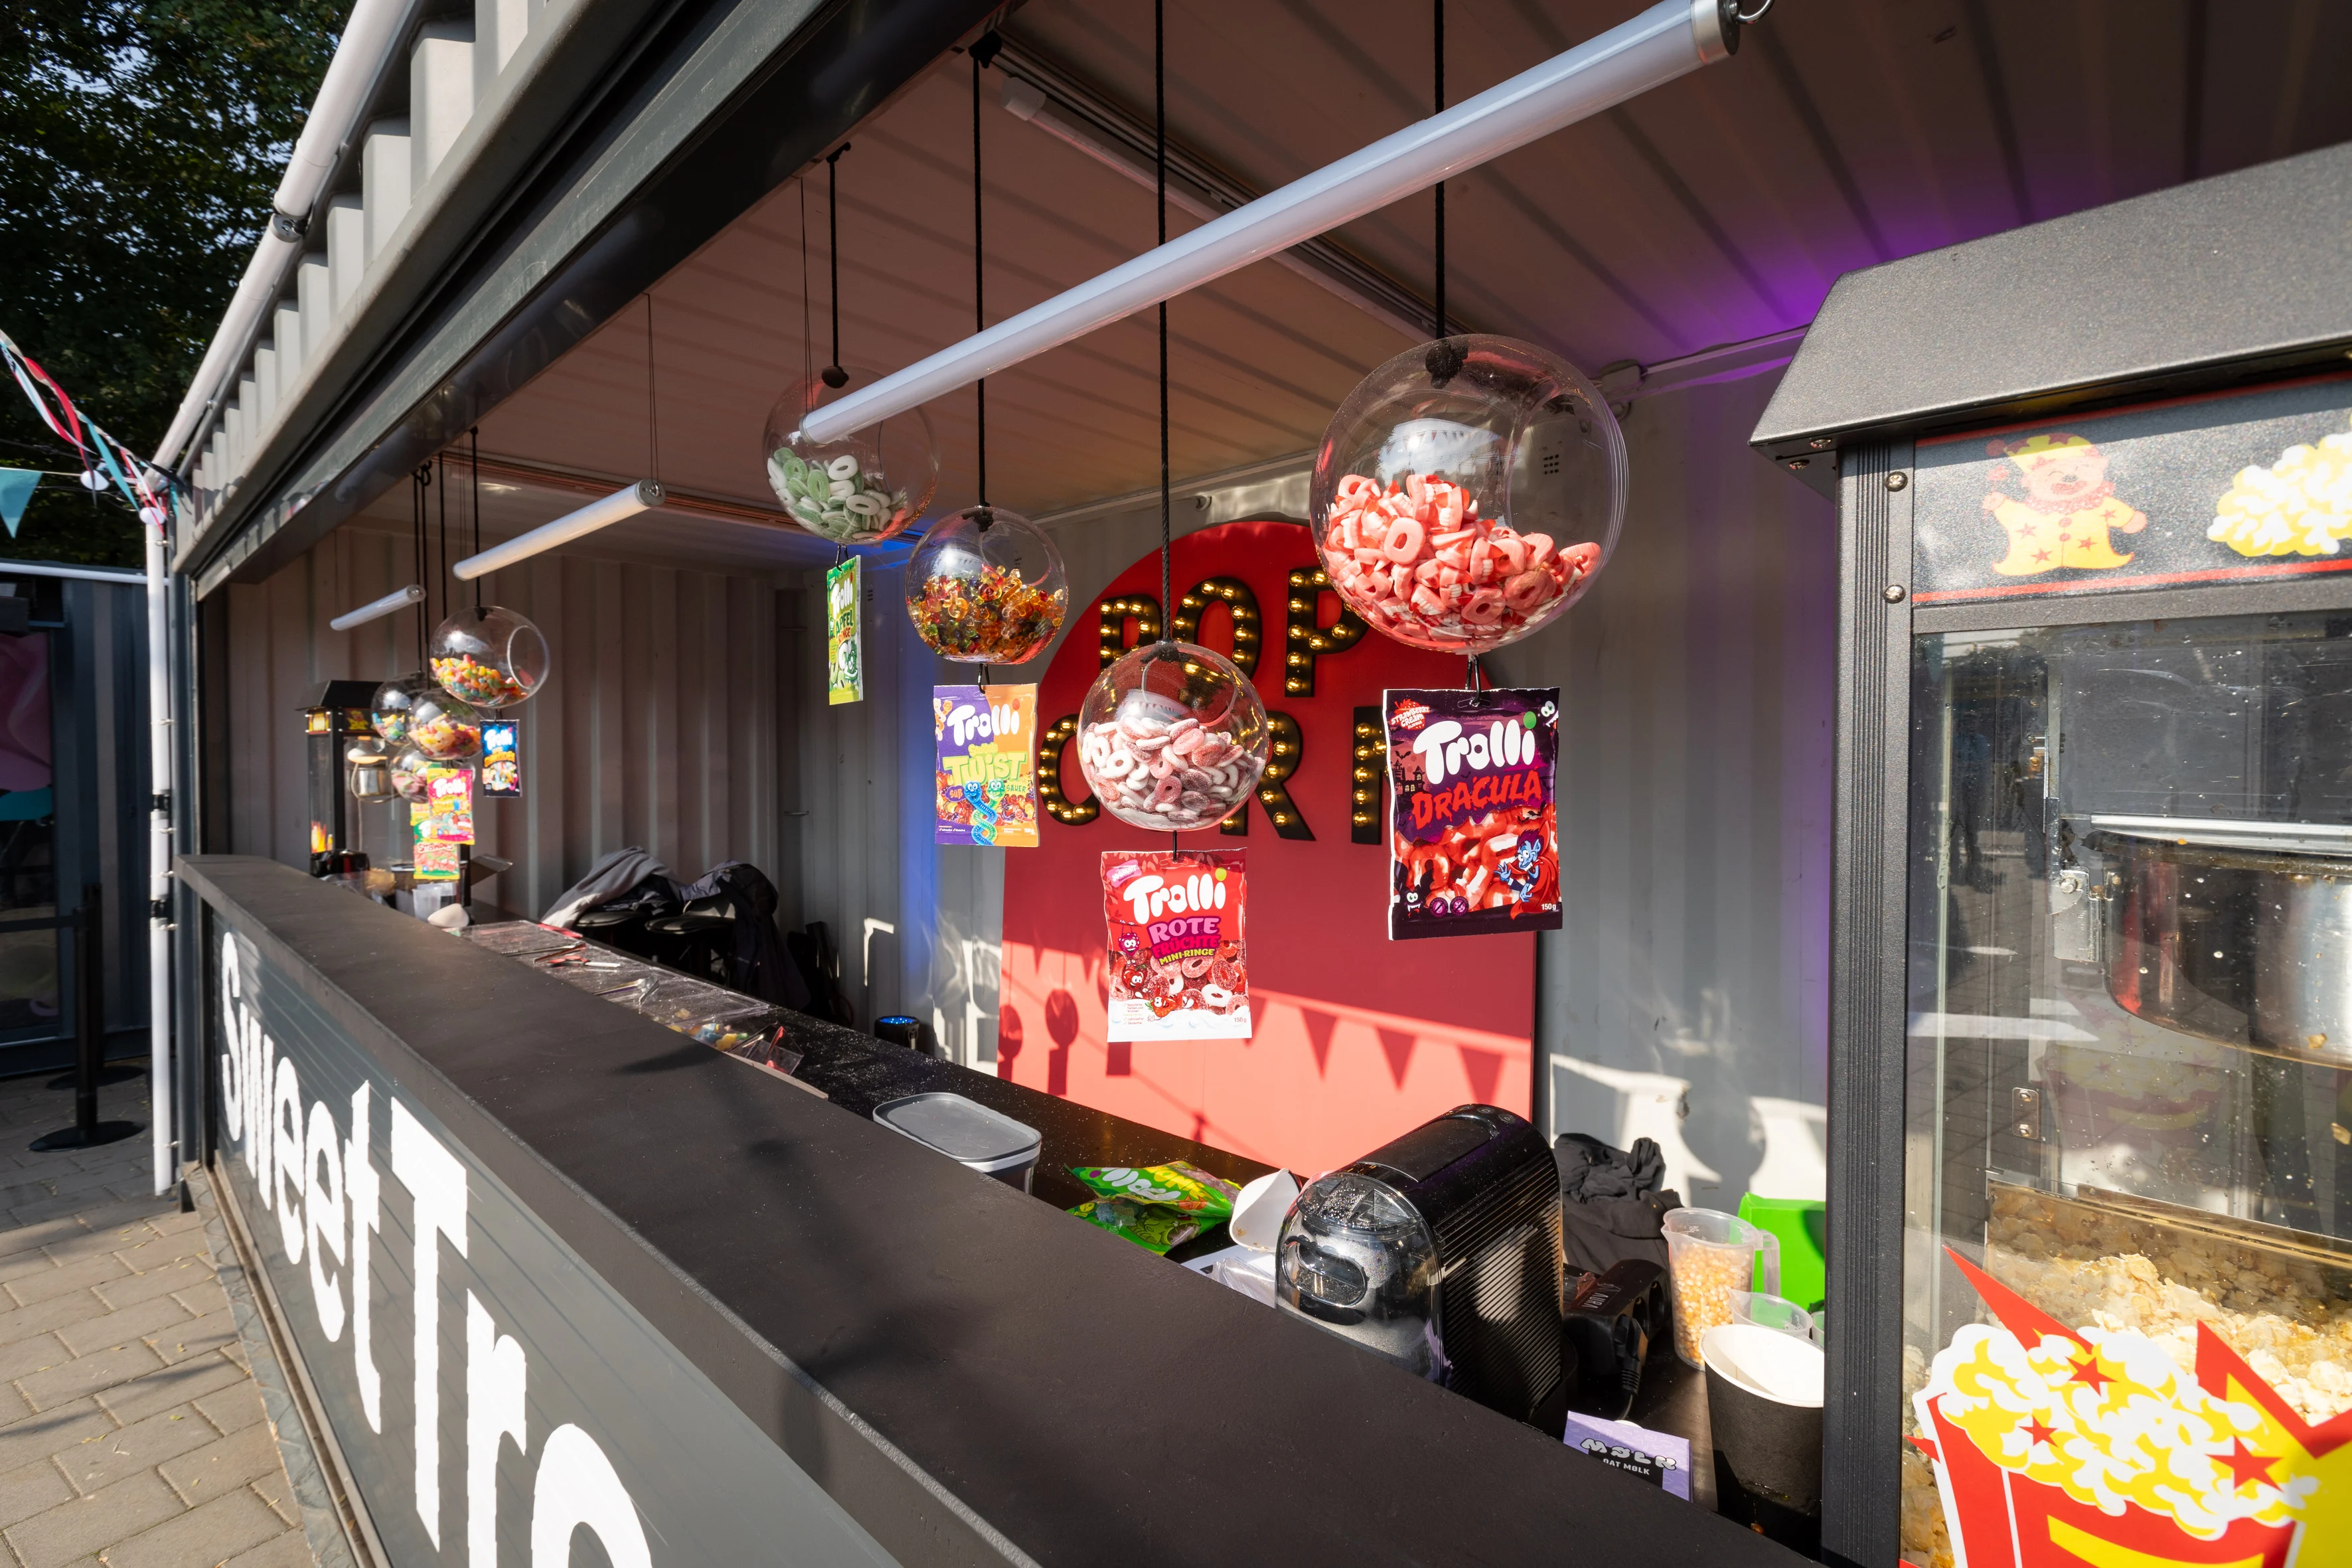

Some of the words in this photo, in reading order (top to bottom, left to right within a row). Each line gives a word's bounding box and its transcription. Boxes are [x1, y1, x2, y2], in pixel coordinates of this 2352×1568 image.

[831, 572, 854, 620] Trolli
[835, 608, 854, 639] APFEL
[947, 698, 1020, 746] Trolli
[1413, 711, 1537, 785] Trolli
[432, 777, 467, 798] Trolli
[1006, 785, 1026, 793] SAUER
[1410, 768, 1543, 831] DRACULA
[1123, 867, 1227, 925] Trolli
[1148, 917, 1219, 945] ROTE
[1151, 935, 1221, 958] FRÜCHTE
[222, 932, 381, 1435] Sweet
[1581, 1292, 1609, 1309] AURA
